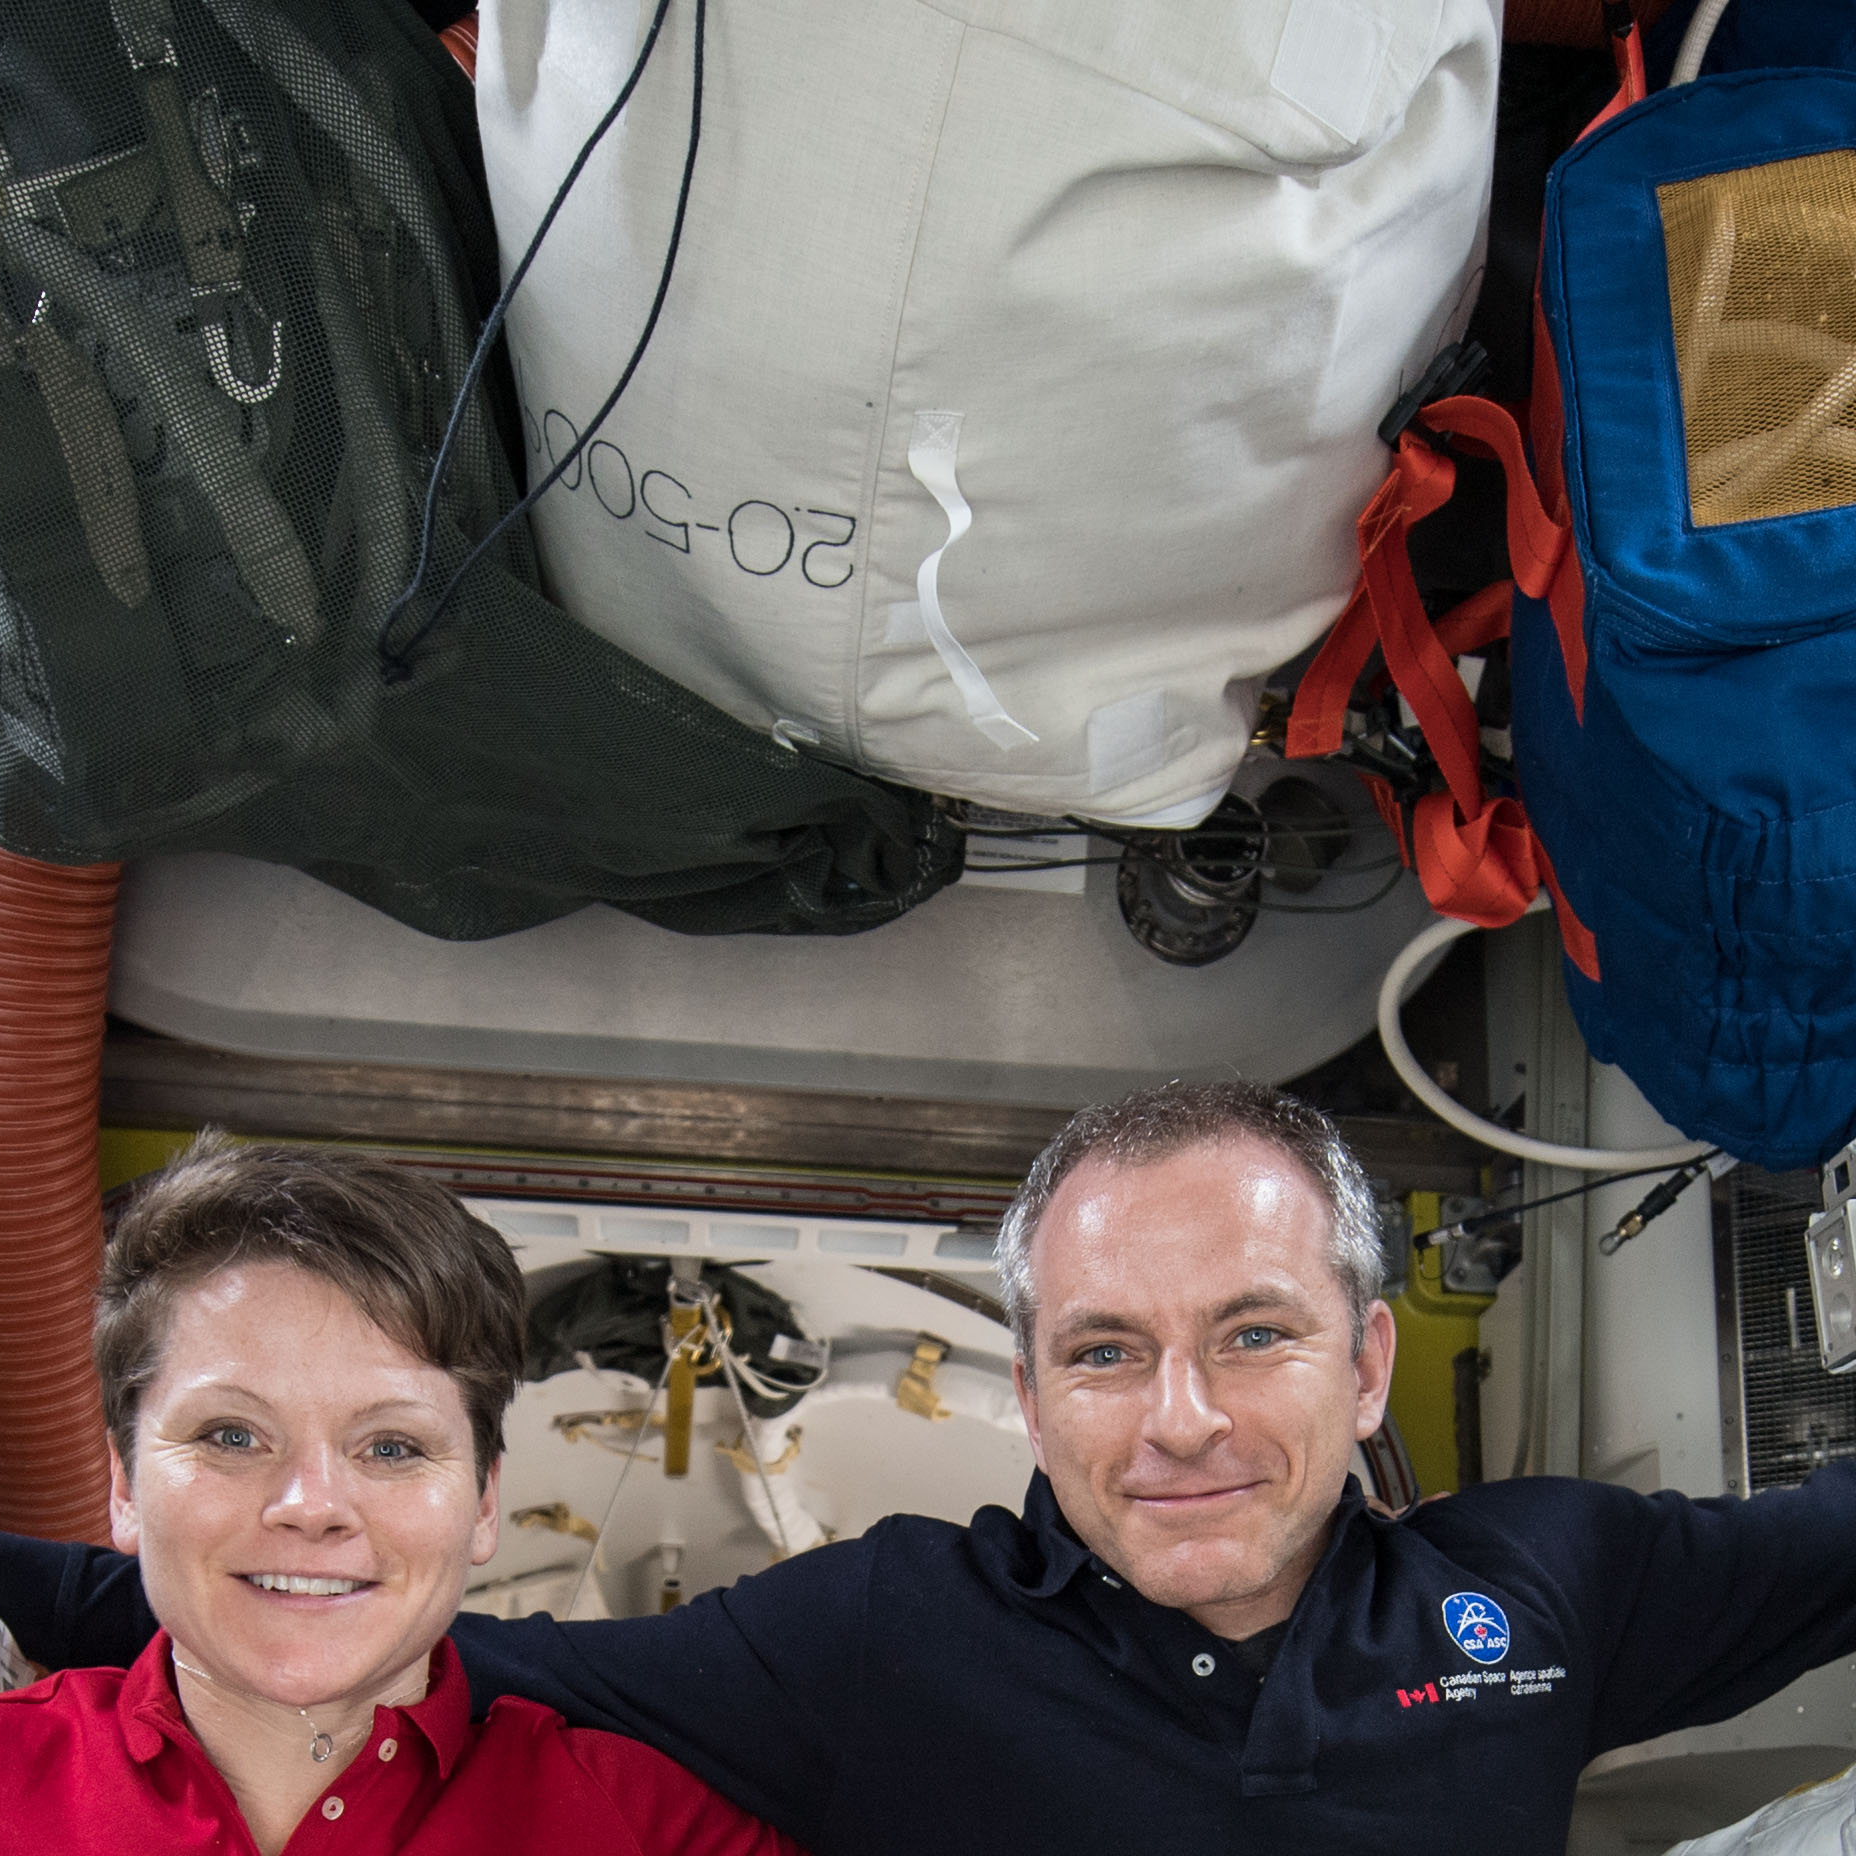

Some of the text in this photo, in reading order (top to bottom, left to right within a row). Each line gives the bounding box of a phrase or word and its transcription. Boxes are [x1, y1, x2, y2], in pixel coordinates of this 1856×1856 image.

[1463, 1636, 1507, 1650] CSA ASC
[1439, 1670, 1506, 1688] Canadian Space
[1445, 1687, 1478, 1702] Agency
